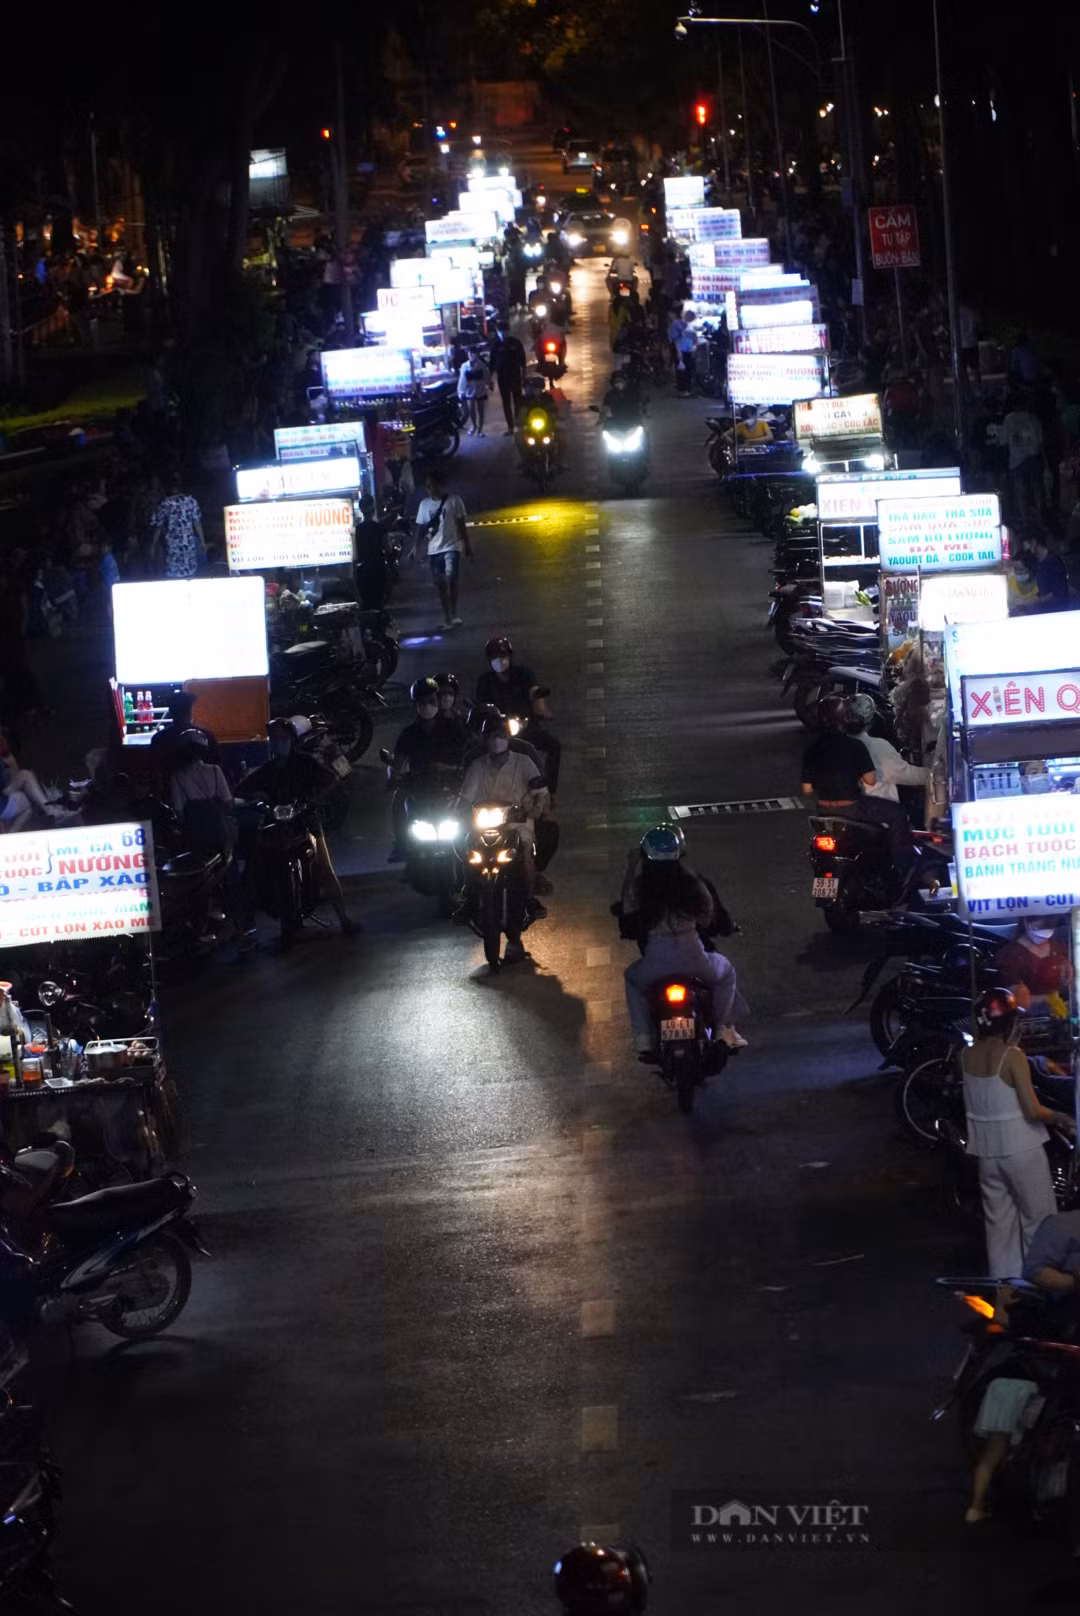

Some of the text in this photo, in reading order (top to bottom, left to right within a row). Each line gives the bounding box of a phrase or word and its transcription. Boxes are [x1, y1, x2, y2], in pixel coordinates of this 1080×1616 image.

[888, 555, 922, 566] YAOURT
[949, 552, 974, 562] COOK
[977, 550, 997, 561] TAIL
[121, 828, 146, 847] 68
